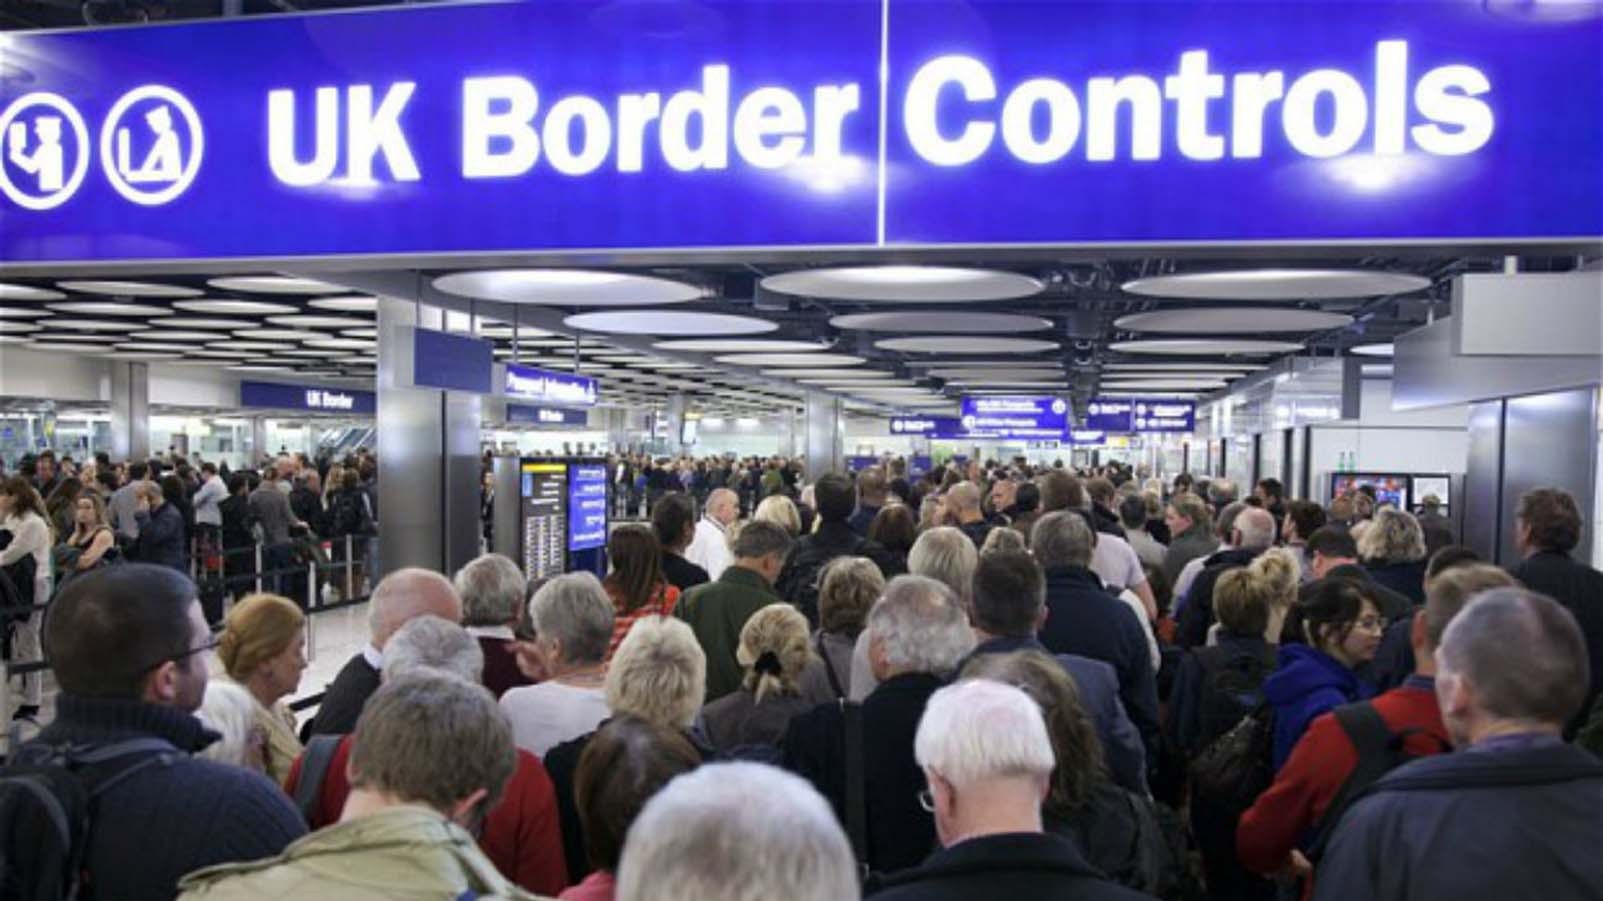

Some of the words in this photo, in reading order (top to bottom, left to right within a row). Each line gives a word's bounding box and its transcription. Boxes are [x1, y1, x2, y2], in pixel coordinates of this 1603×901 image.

[267, 82, 420, 187] UK
[462, 65, 860, 179] Border
[903, 40, 1495, 167] Controls
